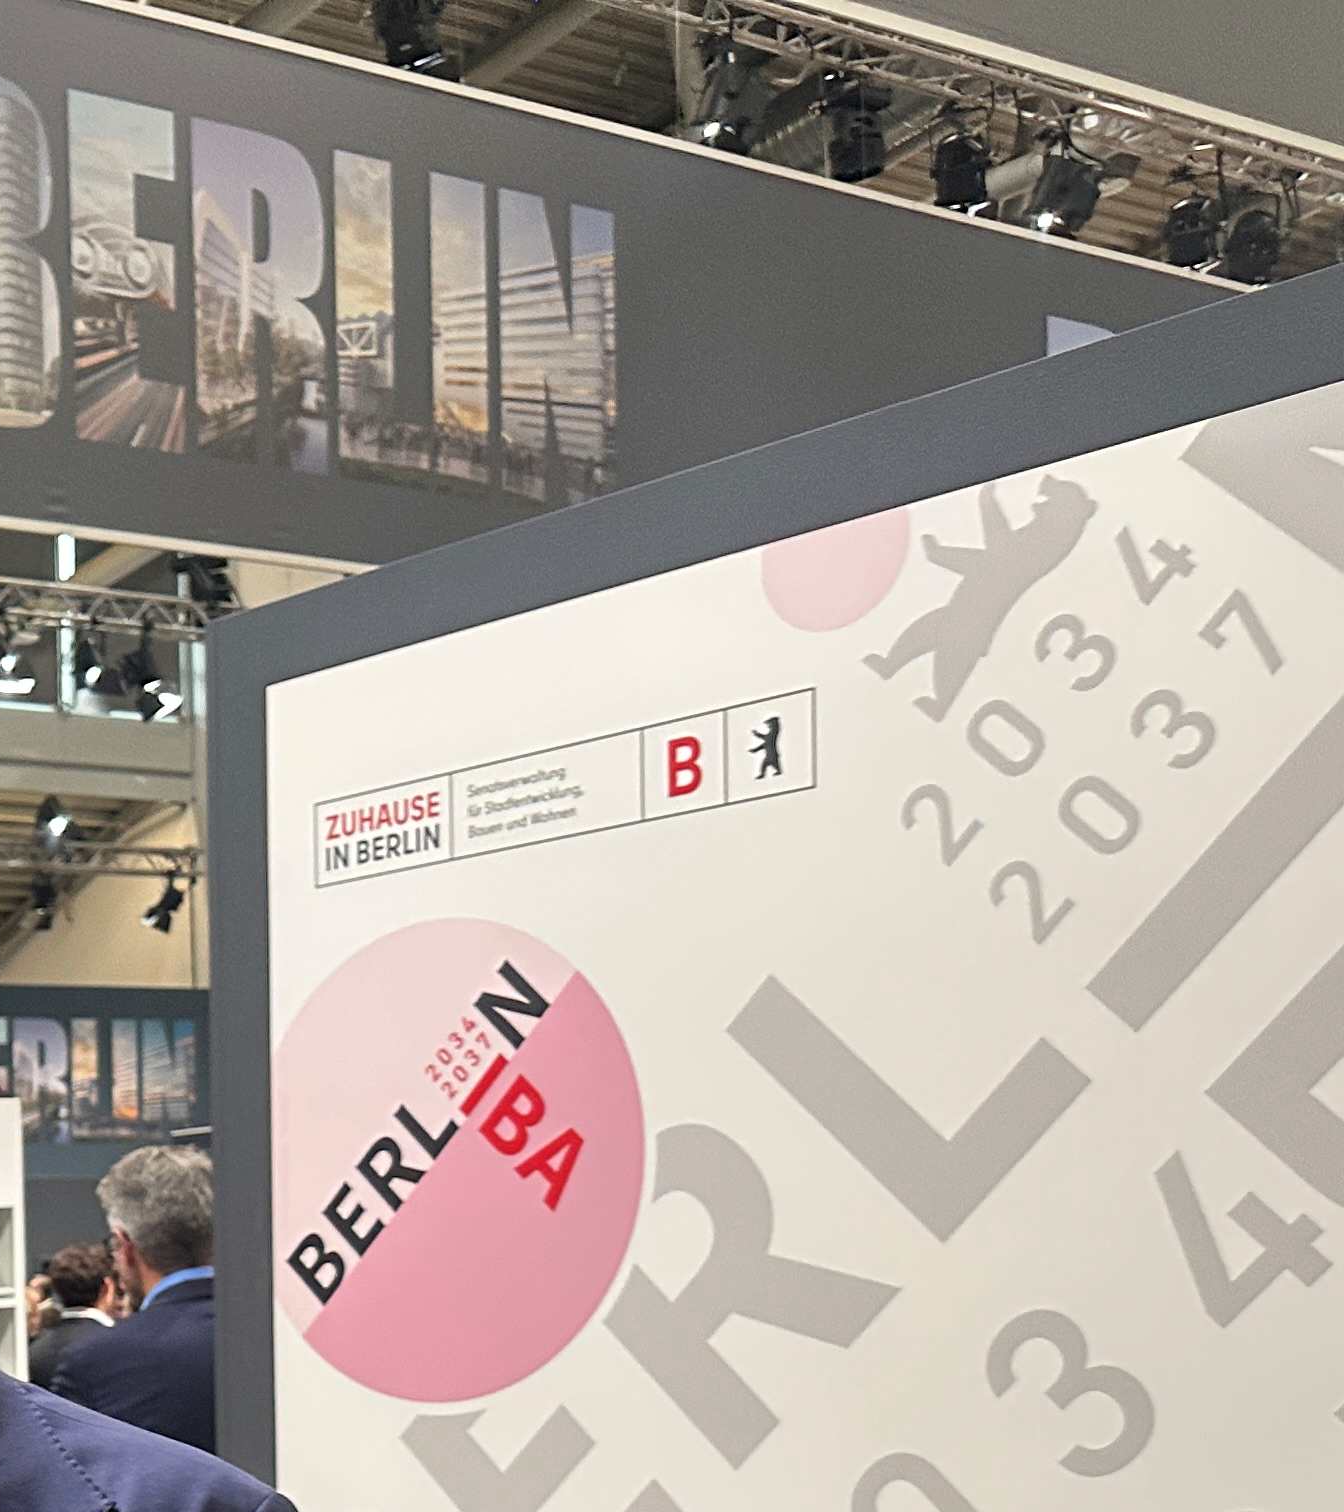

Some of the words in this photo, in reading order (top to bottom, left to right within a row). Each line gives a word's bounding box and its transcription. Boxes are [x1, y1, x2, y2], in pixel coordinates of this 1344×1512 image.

[900, 526, 1197, 867] 2034
[666, 735, 703, 799] B
[988, 588, 1286, 945] 2037
[324, 844, 350, 871] IN
[355, 823, 442, 866] BERLIN
[325, 791, 441, 841] ZUHAUSE
[425, 1016, 476, 1083] 2034
[440, 1031, 491, 1099] 2037
